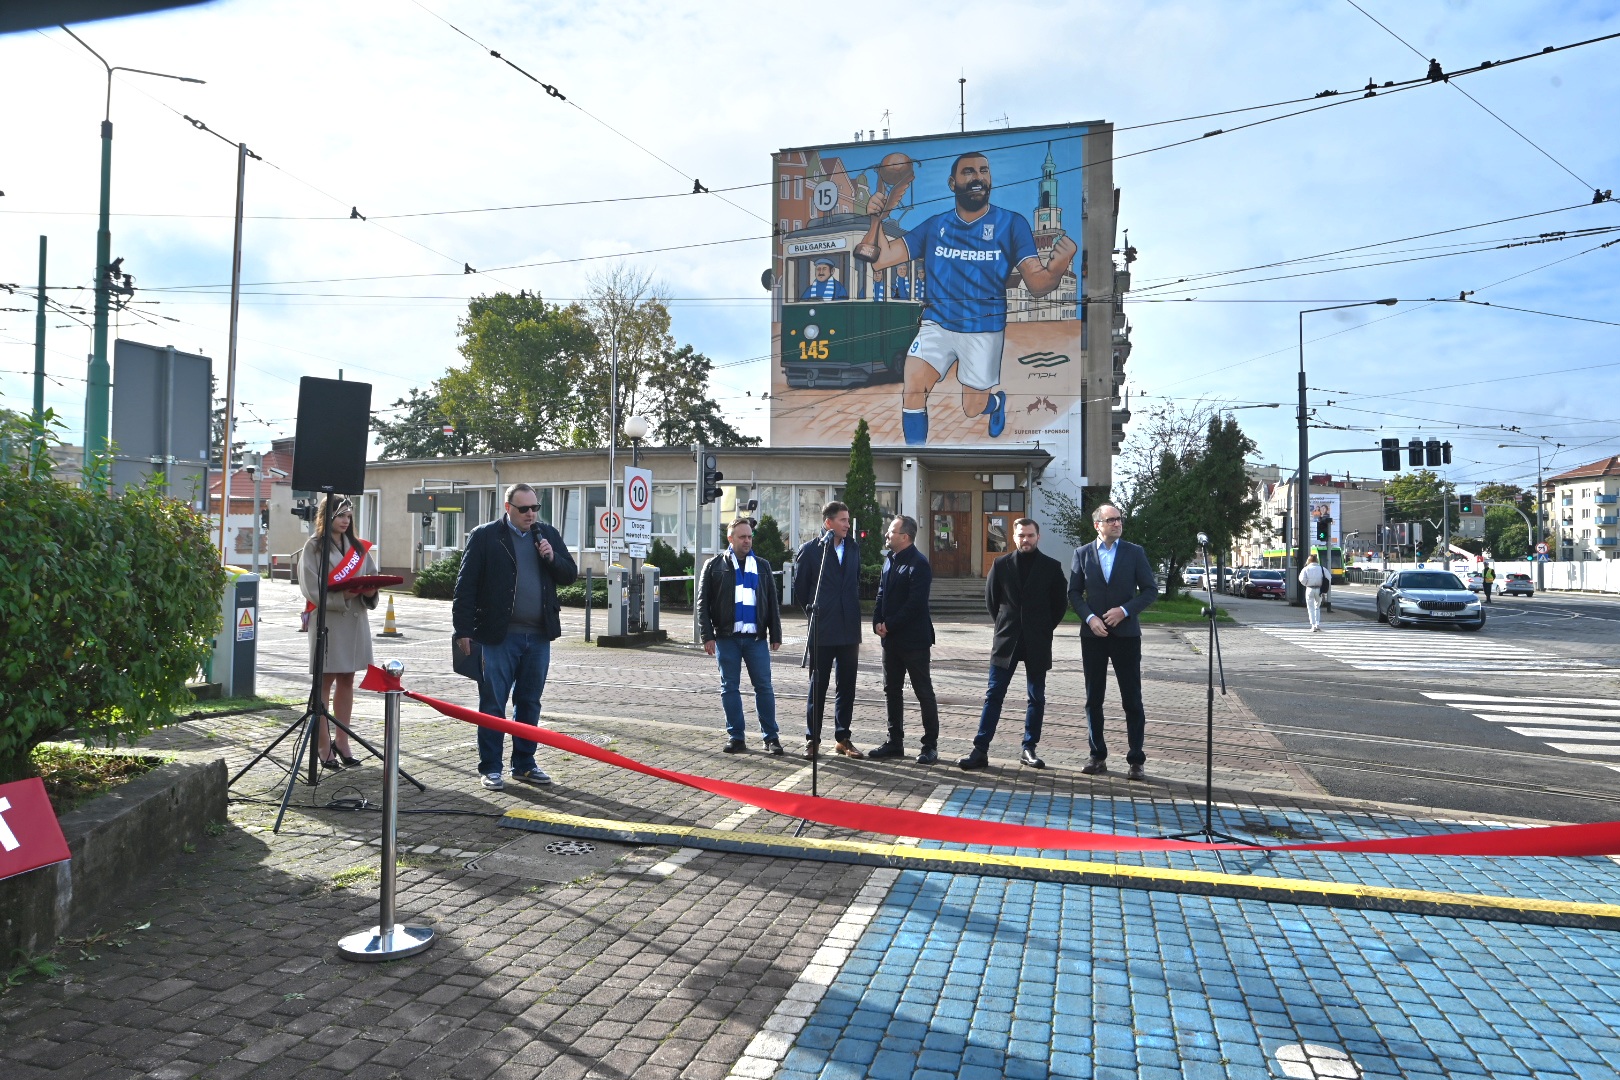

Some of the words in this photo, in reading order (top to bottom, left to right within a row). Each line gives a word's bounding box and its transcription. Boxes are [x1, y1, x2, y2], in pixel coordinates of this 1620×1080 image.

[818, 188, 832, 206] 15
[794, 241, 836, 252] BUŁGARSKA
[934, 246, 1002, 261] SUPERBET
[799, 340, 829, 360] 145
[910, 341, 919, 354] 9
[633, 486, 644, 502] 10
